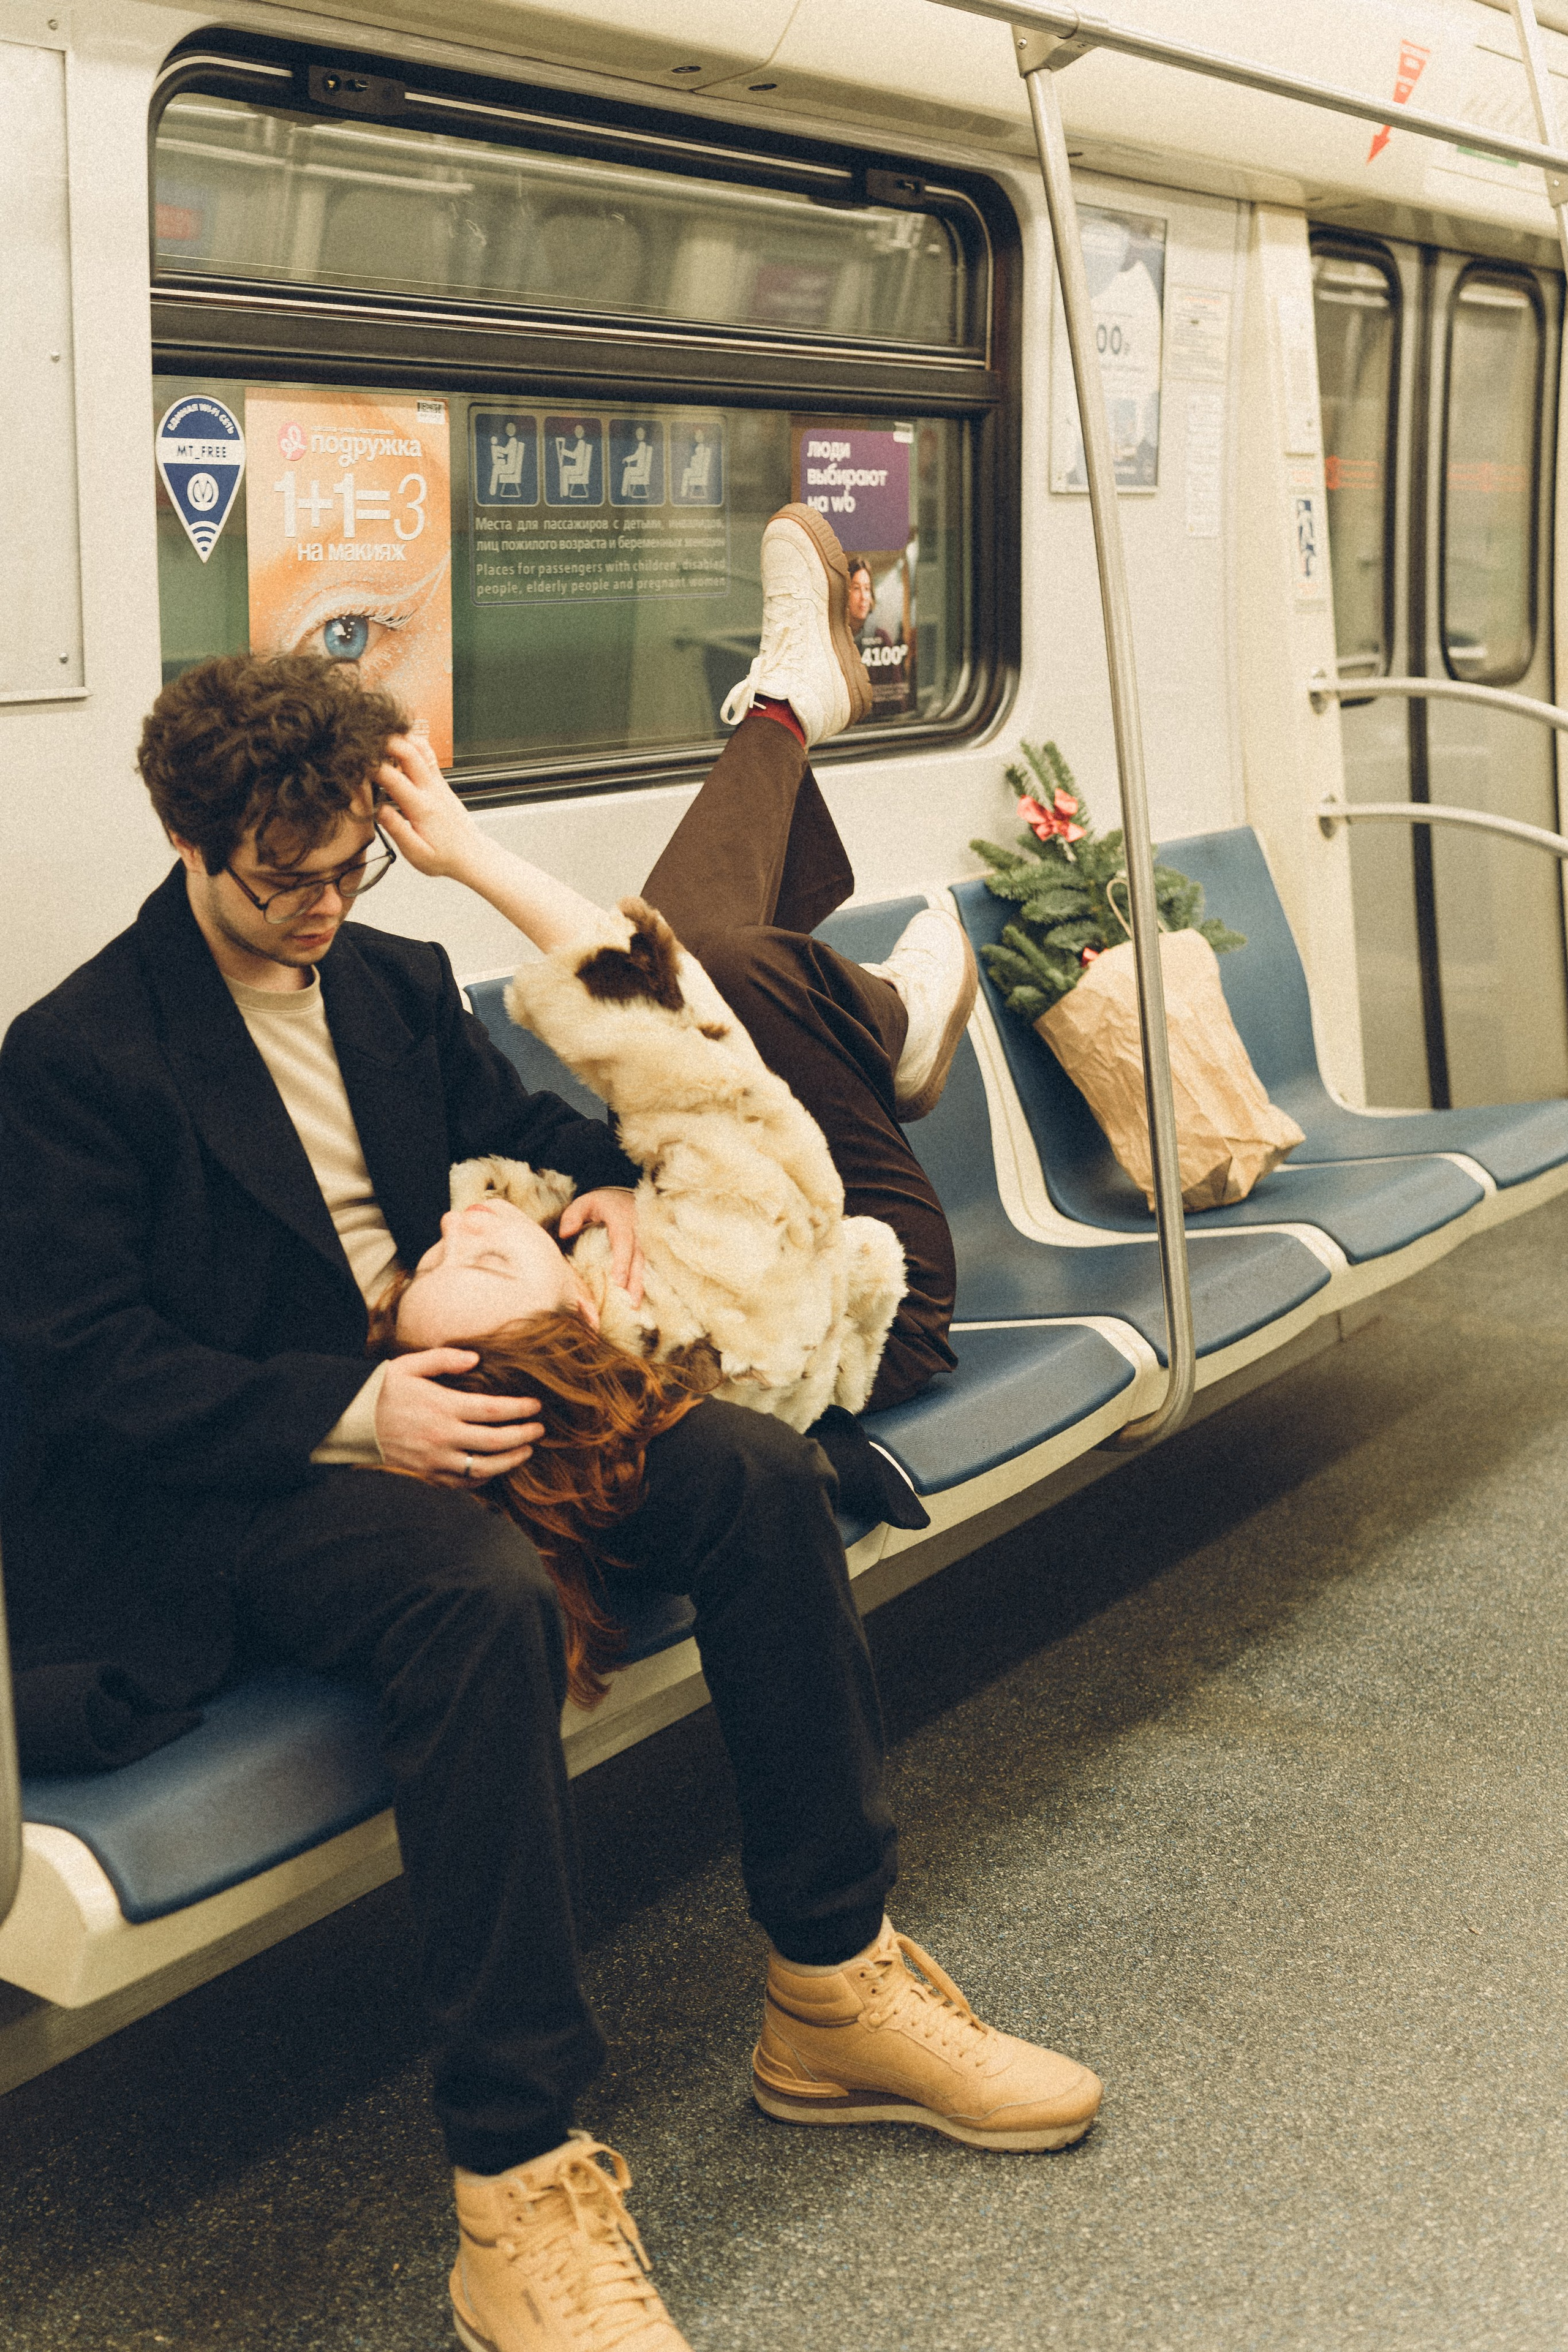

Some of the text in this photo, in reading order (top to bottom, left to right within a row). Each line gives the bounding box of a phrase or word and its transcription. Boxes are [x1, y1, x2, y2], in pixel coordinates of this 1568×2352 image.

[177, 445, 226, 459] MT_FREE
[311, 434, 422, 467] подружка
[807, 441, 851, 461] люди
[807, 463, 888, 490] выбирают
[807, 490, 856, 513] на wb
[475, 518, 513, 530] Места
[516, 519, 538, 532] для
[544, 519, 609, 532] пассажиров
[613, 520, 619, 529] с
[623, 519, 664, 531] детьми,
[298, 543, 407, 562] на макияж
[477, 541, 499, 552] лиц
[501, 540, 557, 551] пожилого
[559, 539, 606, 552] возраста
[609, 539, 616, 548] и
[617, 535, 682, 551] беременных
[476, 558, 725, 577] Places for passengers with children, disabled
[477, 577, 725, 597] people, elderly people and pregnant women
